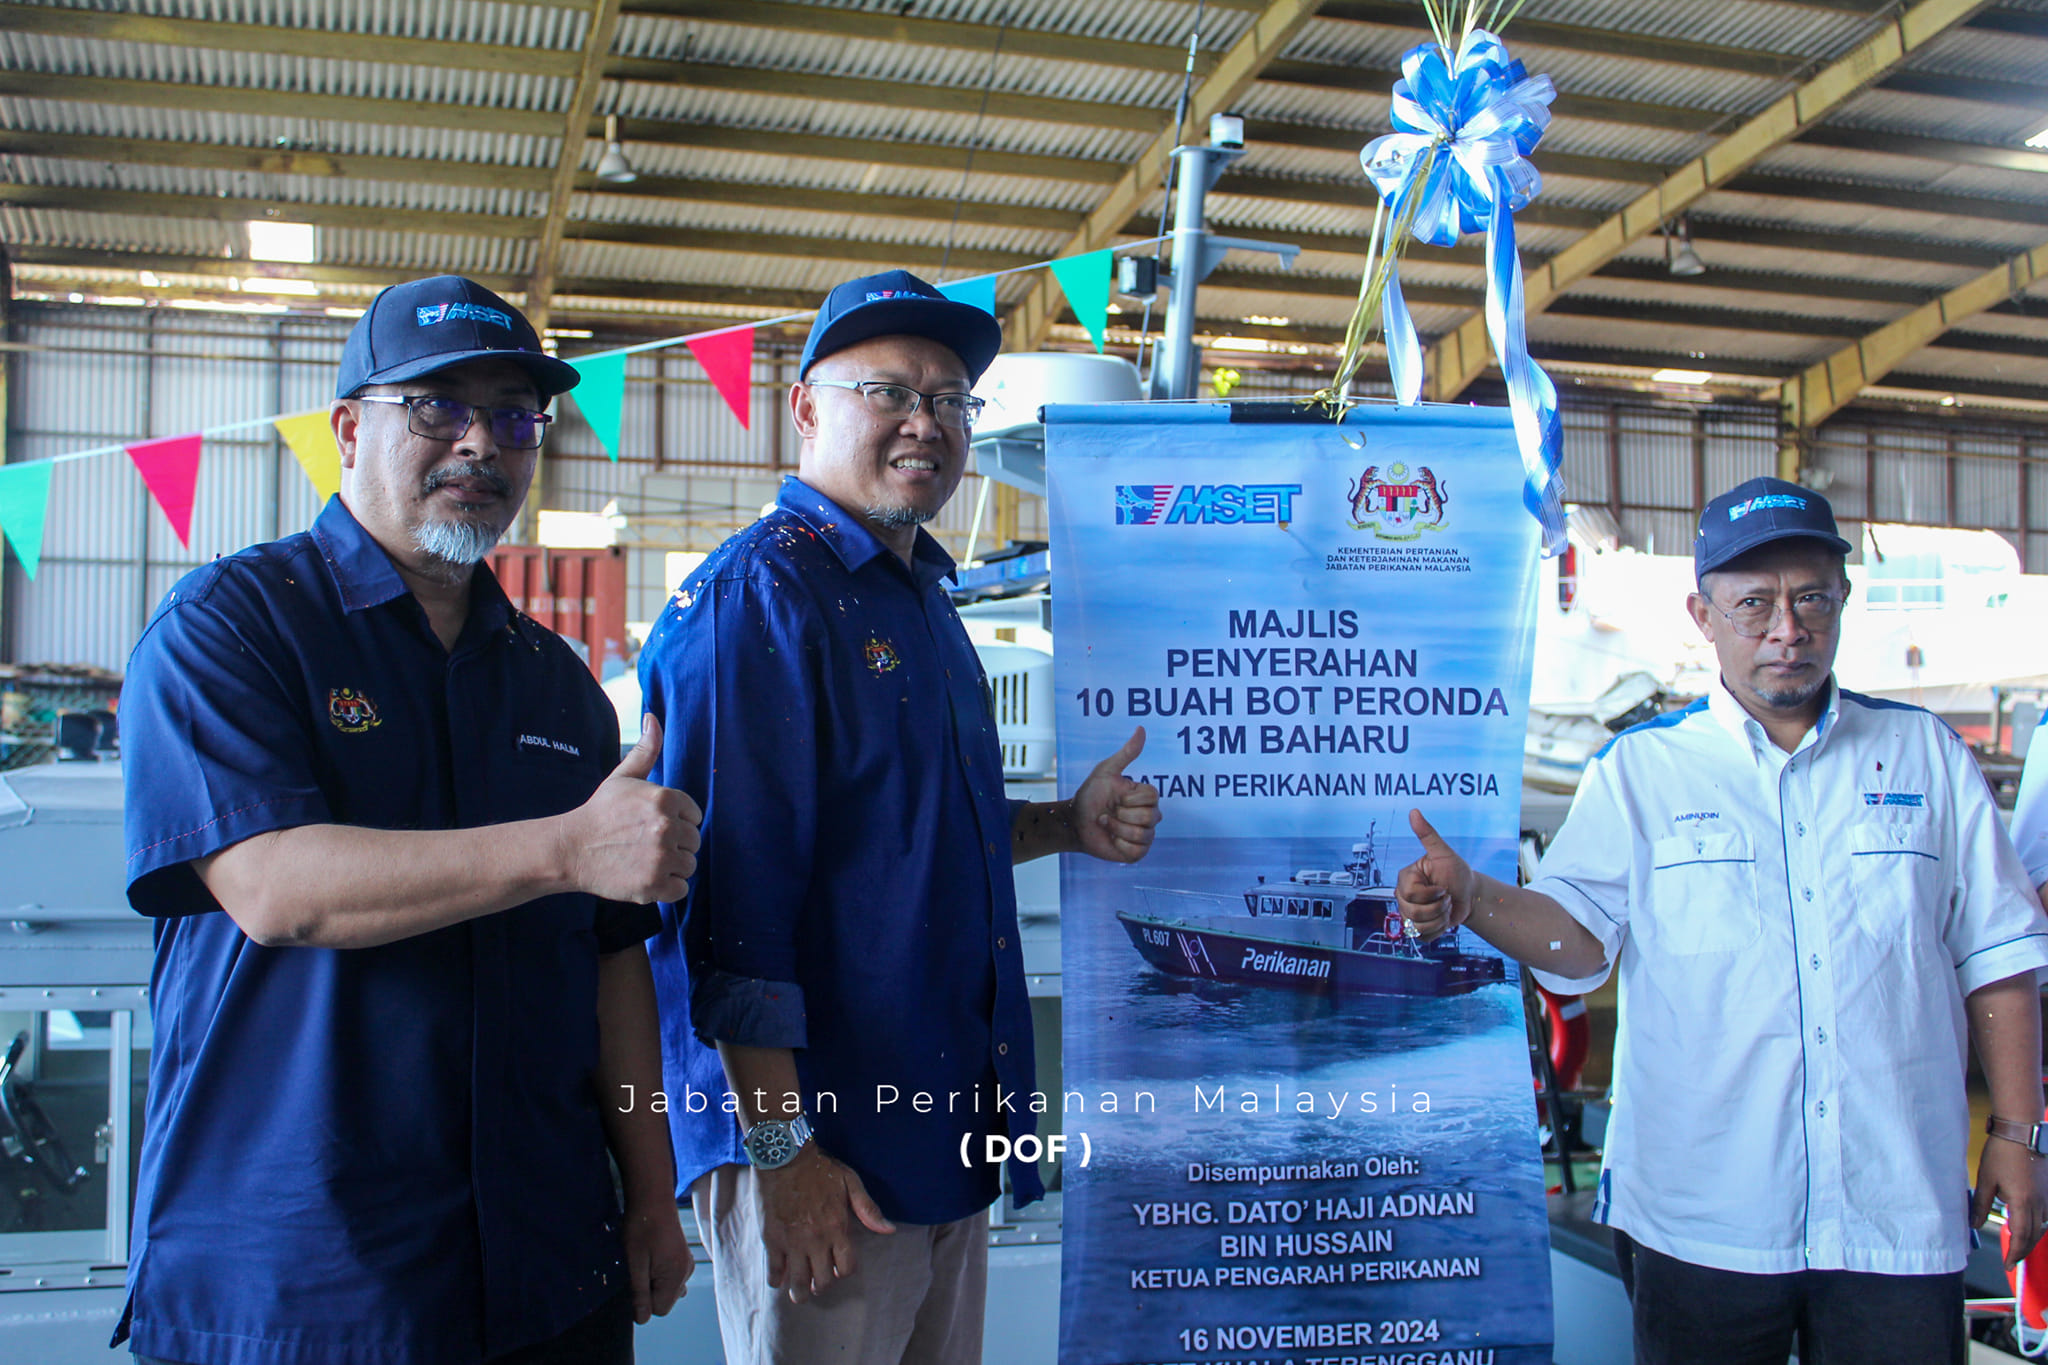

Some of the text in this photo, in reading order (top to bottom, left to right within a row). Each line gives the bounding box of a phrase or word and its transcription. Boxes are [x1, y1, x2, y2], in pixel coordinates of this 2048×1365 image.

[1164, 484, 1302, 524] MSET
[1327, 555, 1346, 563] DAN
[1349, 555, 1420, 563] KETERJAMINAN
[1338, 547, 1403, 555] KEMENTERIAN
[1326, 563, 1471, 572] JABATAN PERIKANAN MALAYSIA
[1229, 610, 1359, 639] MAJLIS
[1167, 648, 1418, 678] PENYERAHAN
[1077, 686, 1509, 717] 10 BUAH BOT PERONDA
[520, 734, 580, 756] ABDUL HALIM
[1177, 725, 1409, 755] 13M BAHARU
[1215, 773, 1367, 797] PERIKANAN
[1374, 772, 1499, 797] MALAYSIA
[1674, 812, 1720, 822] AMINUDIN
[1241, 948, 1331, 978] Perikanan
[1187, 1156, 1420, 1187] Disempurnakan Oleh:
[1133, 1202, 1220, 1227] YBHG.
[1315, 1195, 1373, 1221] HAJI
[1381, 1192, 1475, 1218] ADNAN
[1220, 1229, 1393, 1258] BIN HUSSAIN
[1130, 1257, 1480, 1289] KETUA PENGARAH PERIKANAN
[1179, 1318, 1440, 1352] 16 NOVEMBER 2024
